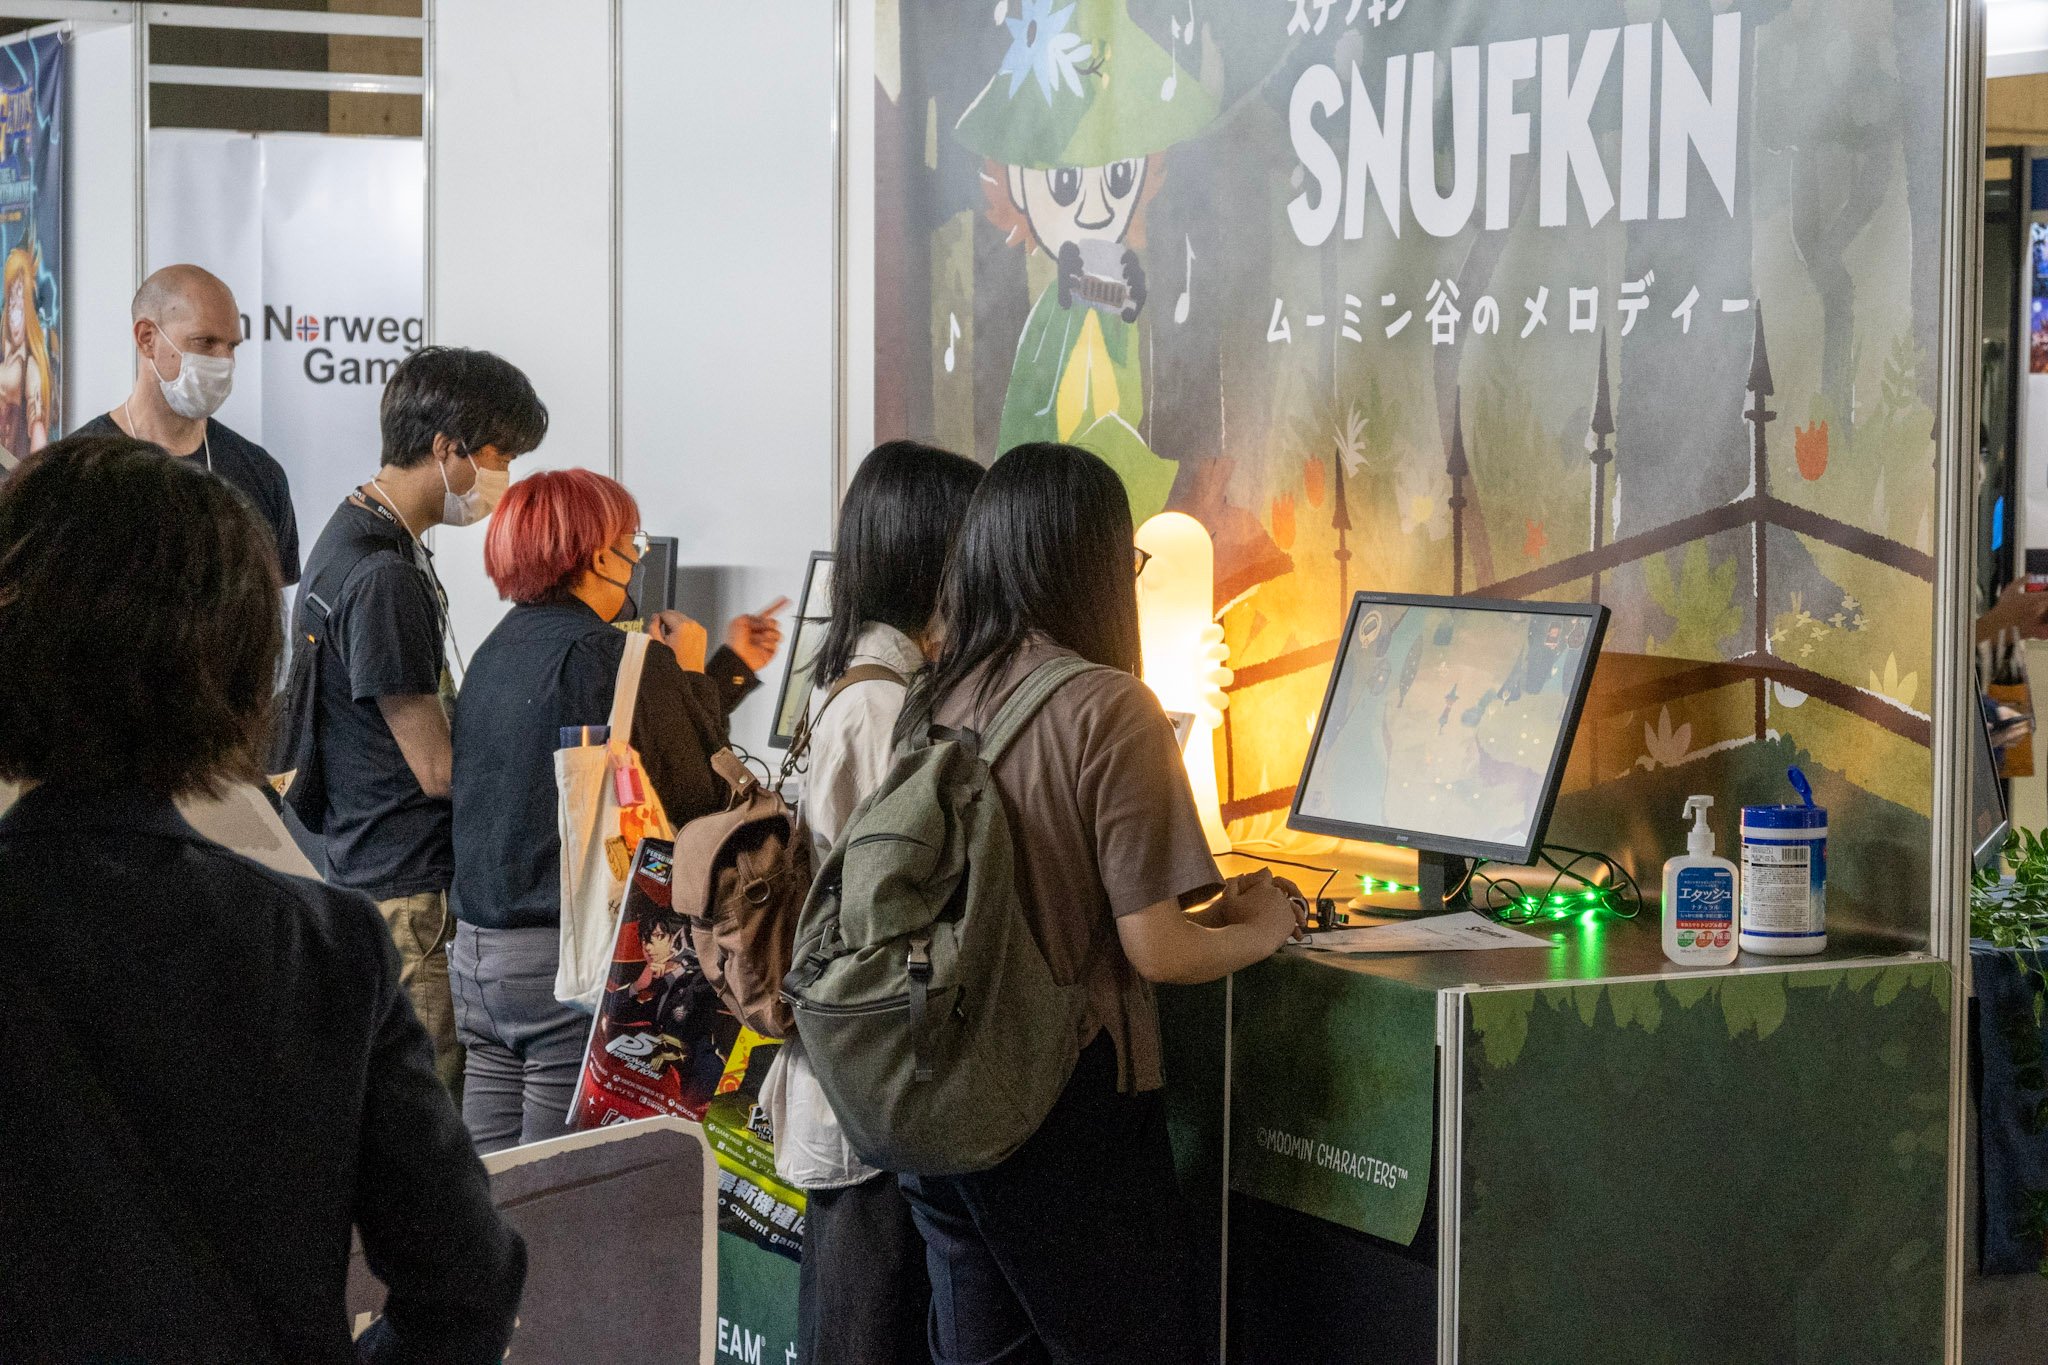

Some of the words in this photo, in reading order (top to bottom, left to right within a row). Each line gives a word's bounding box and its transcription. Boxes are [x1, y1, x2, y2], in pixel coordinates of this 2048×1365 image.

[1287, 12, 1741, 247] SNUFKIN
[1266, 270, 1750, 345] ムーミン谷のメロディー
[377, 505, 398, 524] LIONS
[637, 1067, 664, 1080] ROYAL
[730, 1203, 771, 1237] current
